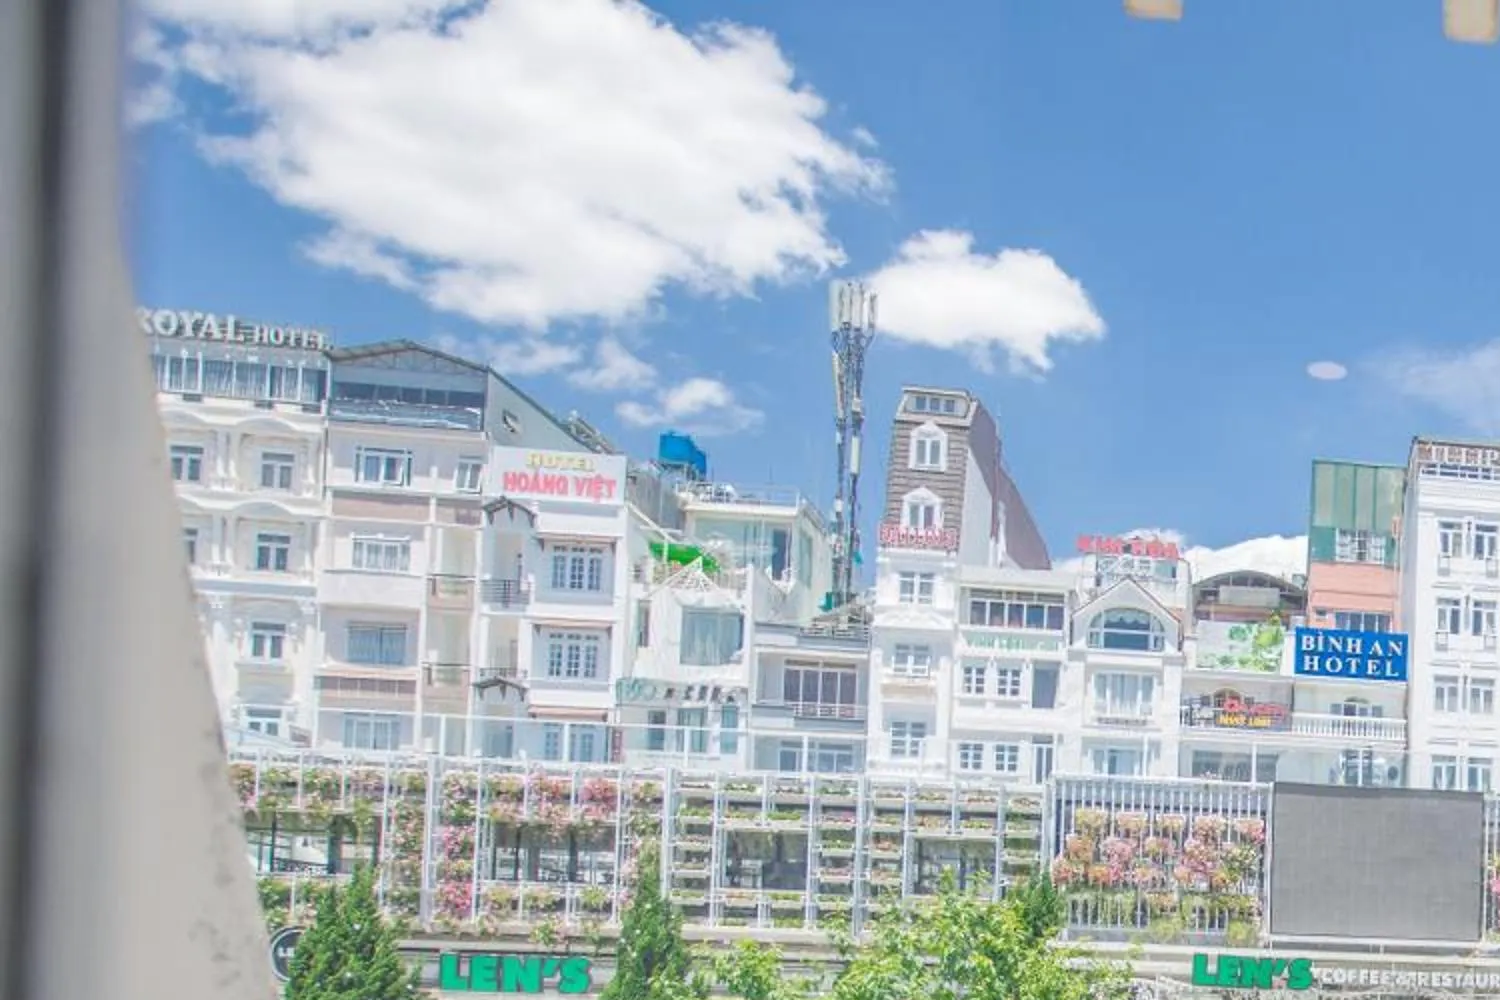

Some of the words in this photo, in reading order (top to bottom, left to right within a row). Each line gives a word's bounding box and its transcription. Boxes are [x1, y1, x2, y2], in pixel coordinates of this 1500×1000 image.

[254, 324, 331, 350] HOTEL
[1302, 632, 1363, 654] BÌNH
[1369, 640, 1403, 656] AN
[1304, 656, 1399, 676] HOTEL
[440, 952, 592, 993] LEN'S
[1192, 953, 1313, 990] LEN'S
[1322, 968, 1391, 986] COFFEE
